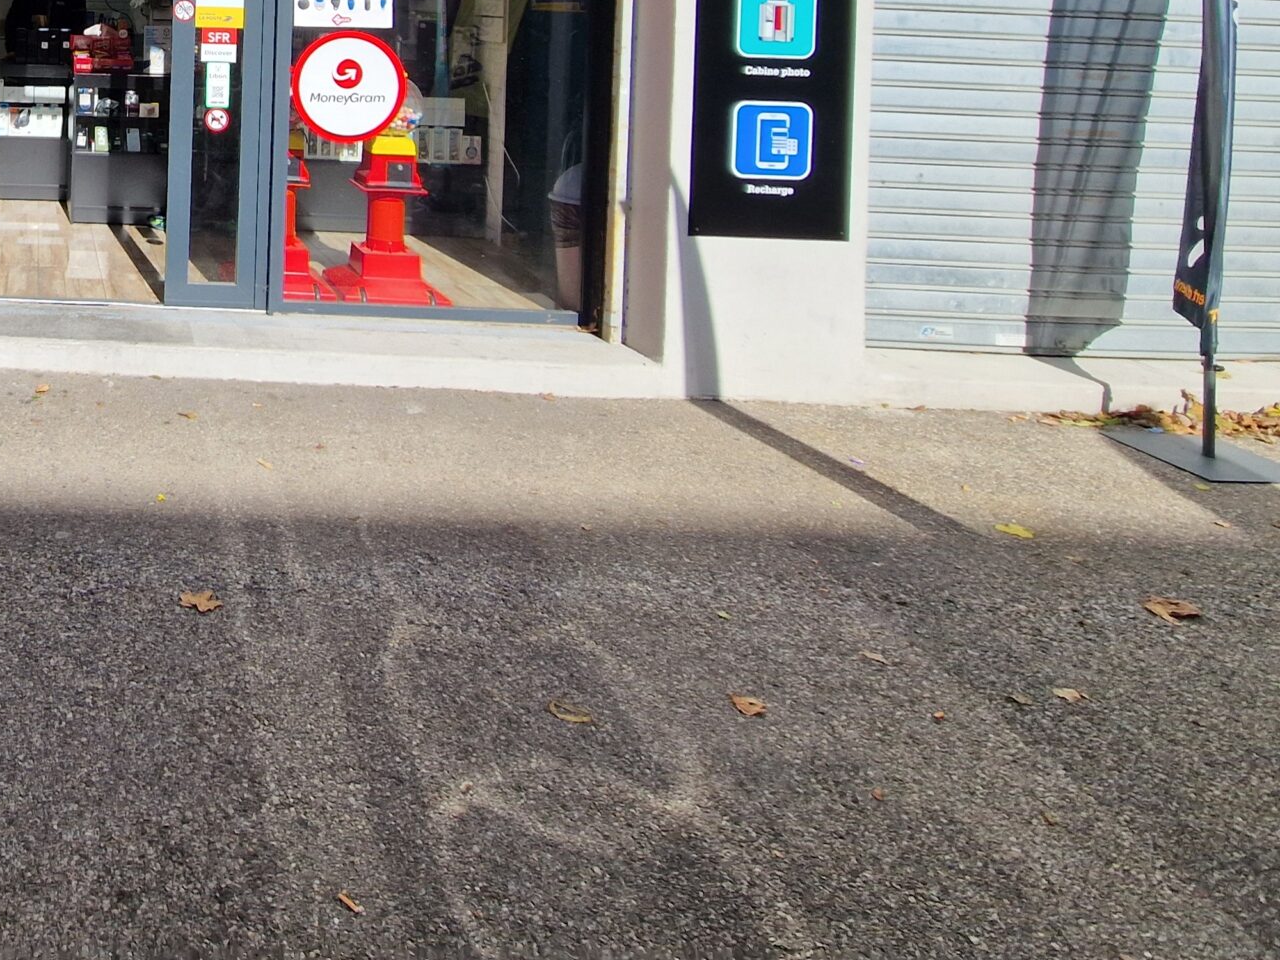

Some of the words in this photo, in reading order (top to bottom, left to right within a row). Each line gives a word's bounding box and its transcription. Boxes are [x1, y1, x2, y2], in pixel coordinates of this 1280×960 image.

[207, 33, 230, 43] SFR
[744, 66, 779, 77] Cabine
[780, 68, 811, 78] photo
[309, 93, 385, 105] MoneyGram
[746, 185, 794, 196] Recharge
